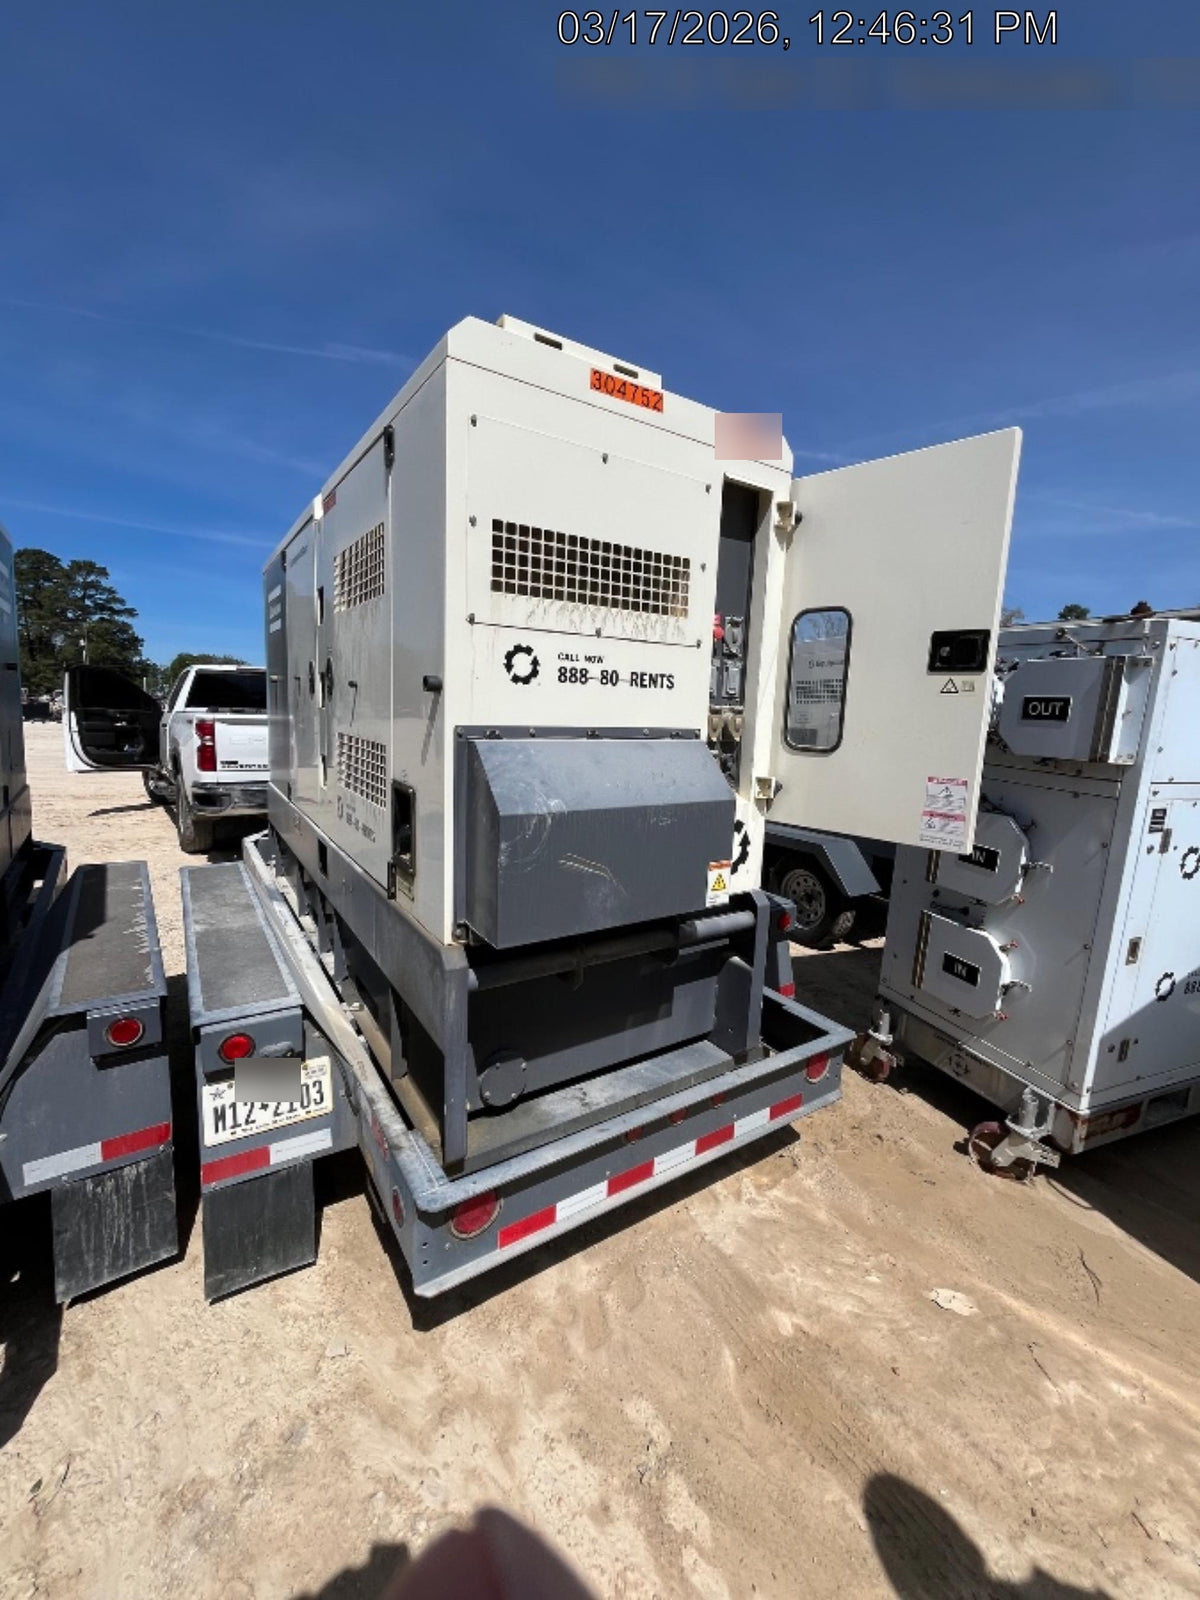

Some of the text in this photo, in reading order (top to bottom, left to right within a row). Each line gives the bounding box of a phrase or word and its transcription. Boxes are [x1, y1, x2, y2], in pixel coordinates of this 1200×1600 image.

[592, 370, 662, 413] 304752
[557, 652, 580, 663] CALL
[1028, 701, 1065, 716] OUT
[953, 961, 969, 978] IN
